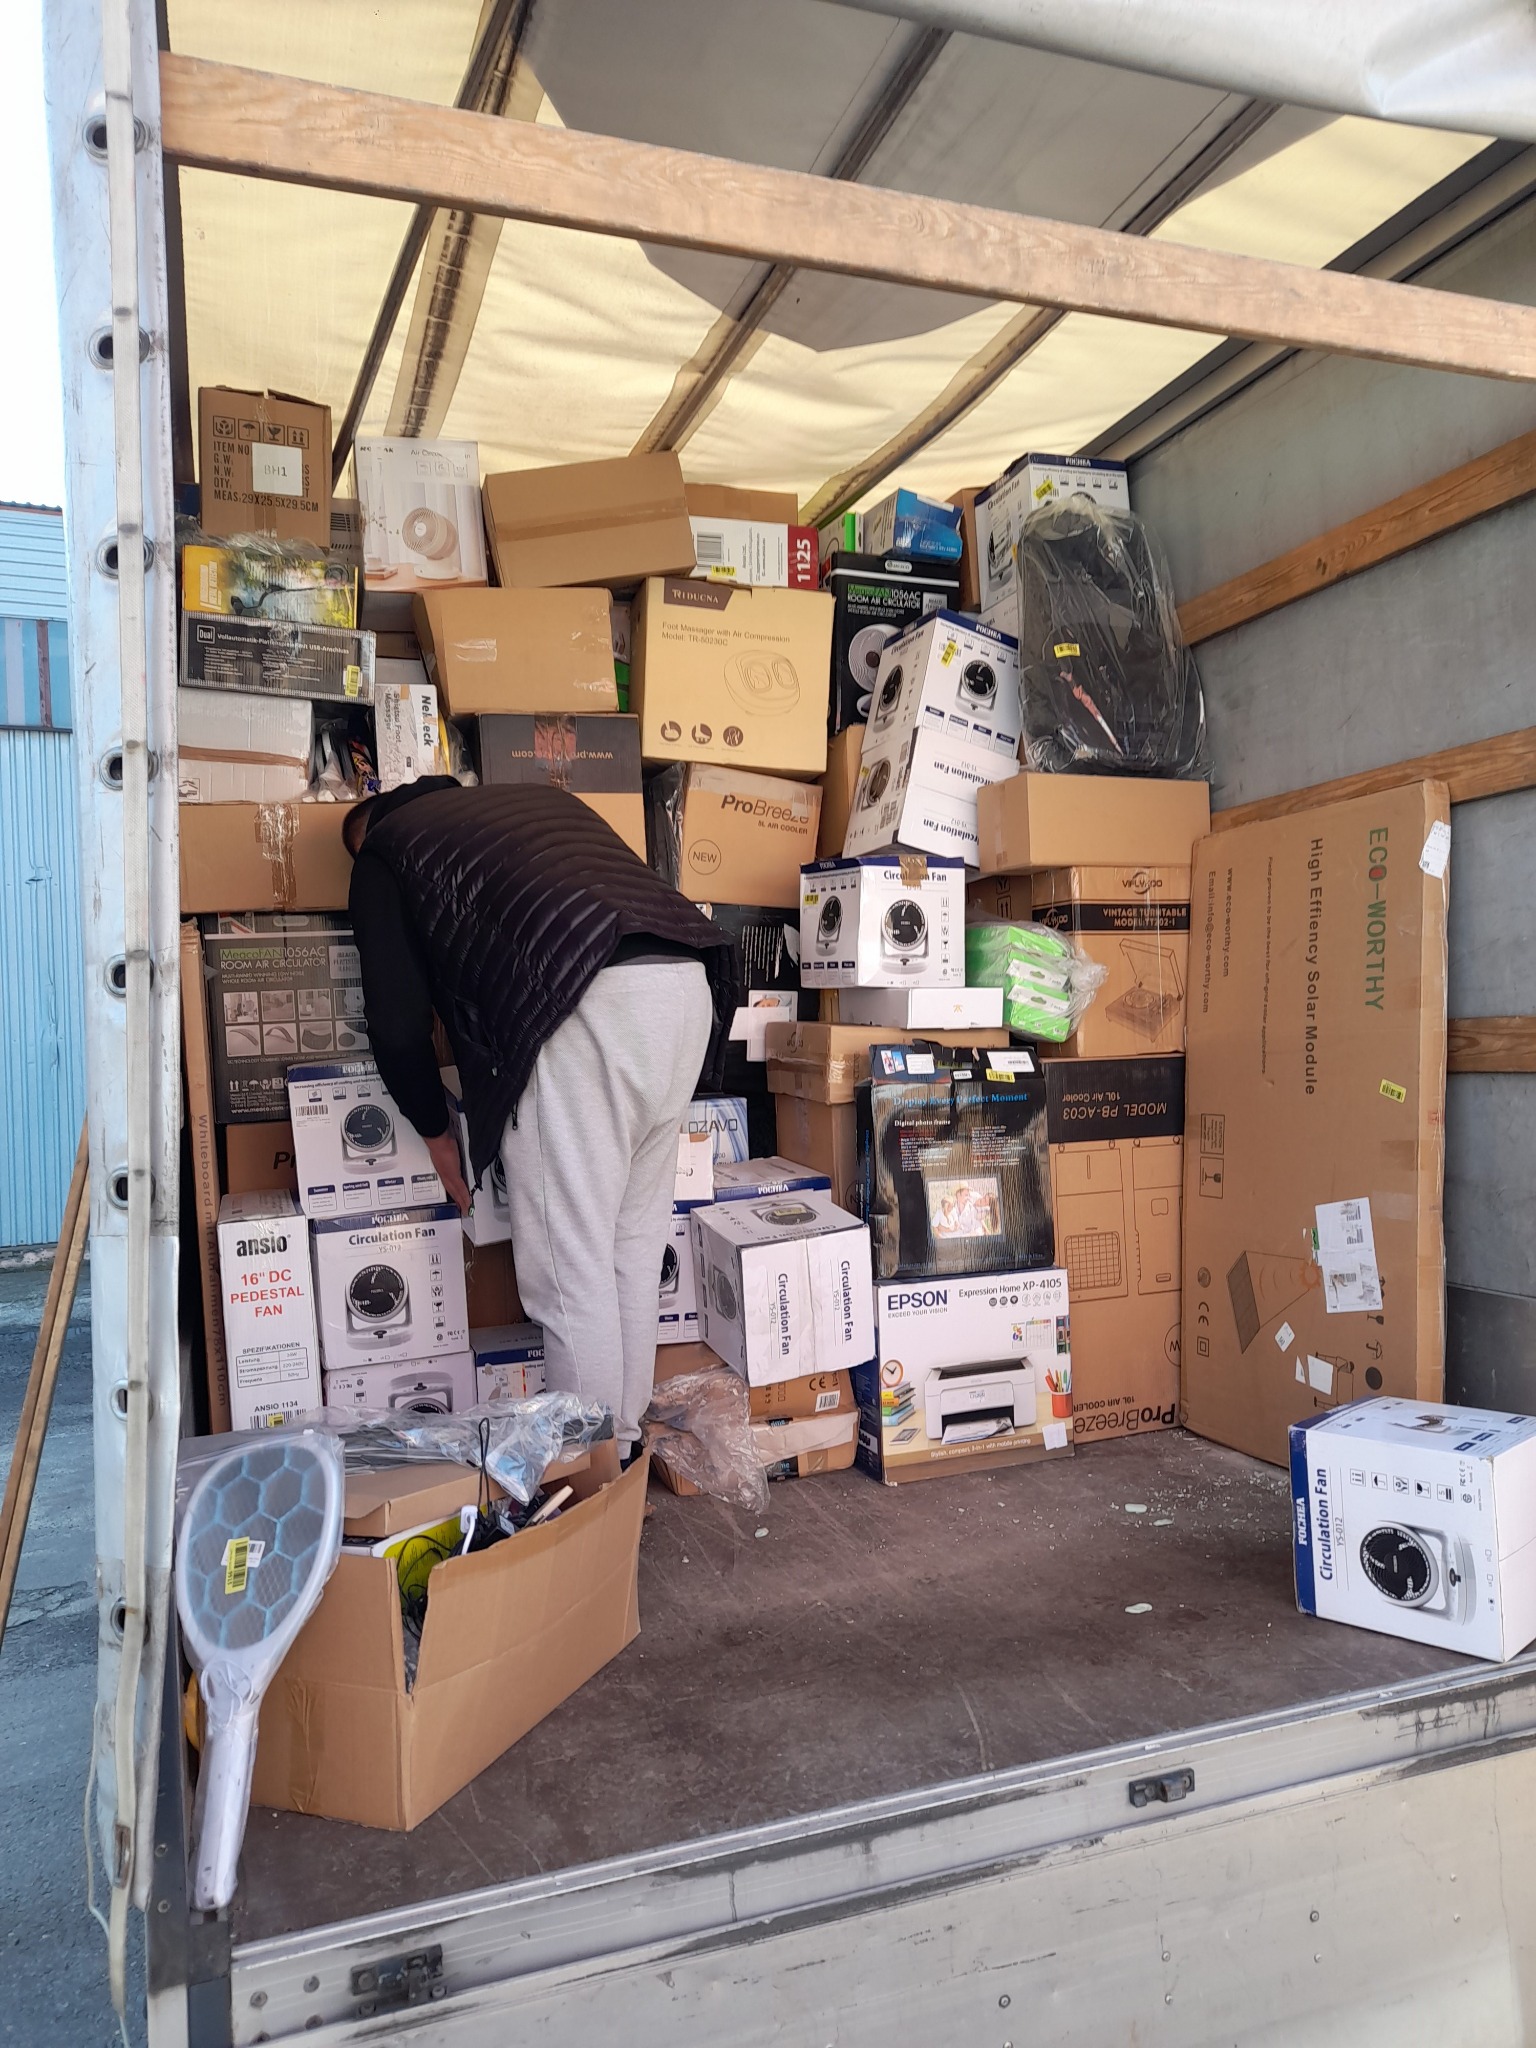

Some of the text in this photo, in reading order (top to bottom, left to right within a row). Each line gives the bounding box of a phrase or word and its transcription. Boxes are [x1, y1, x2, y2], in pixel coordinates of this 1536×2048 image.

[214, 441, 234, 453] ITEM
[264, 464, 287, 477] BH1
[797, 538, 810, 582] 1125
[848, 594, 869, 604] ROOM
[871, 596, 881, 605] AIR
[883, 597, 921, 609] CIRCULATOR
[200, 630, 213, 640] Dual
[662, 622, 790, 643] Foot Massager with Air Compression
[662, 632, 686, 642] Model:
[309, 644, 349, 654] USB-Anschluss
[934, 761, 950, 774] Fan
[780, 824, 808, 835] COOLER
[924, 819, 939, 831] Fan
[693, 851, 717, 863] NEW
[932, 872, 947, 881] Fan
[1102, 908, 1186, 917] VINTAGE TURNTABLE
[1365, 827, 1388, 1010] ECO-WORTHY
[1222, 867, 1234, 977] www.eco-worthy.com
[284, 946, 325, 958] 1056AC
[221, 960, 252, 970] ROOM
[255, 960, 269, 969] AIR
[273, 958, 326, 968] CIRCULATOR
[1305, 838, 1323, 1095] High Effiency Solar Module
[894, 1092, 1027, 1109] Display Every Perfect Moment
[1062, 1092, 1120, 1103] 10L Air Cooler
[231, 1106, 284, 1114] www.meaco.com
[1063, 1102, 1167, 1120] MODEL PB-AC03
[894, 1120, 914, 1129] Digital
[916, 1119, 932, 1128] photo
[198, 1114, 217, 1236] Whiteboard mit
[349, 1227, 436, 1245] Circulation Fan
[236, 1231, 287, 1256] ansio
[269, 1269, 292, 1283] DC
[230, 1286, 304, 1304] PEDESTAL
[959, 1278, 1062, 1300] Expression Home XP-4105
[840, 1260, 853, 1341] Circulation Fan
[888, 1290, 948, 1310] EPSON
[255, 1304, 282, 1318] FAN
[778, 1273, 791, 1355] Circulation Fan
[888, 1310, 911, 1318] EXCEED
[254, 1400, 298, 1412] ANSIO 1134
[1074, 1400, 1105, 1412] COOLER
[1108, 1398, 1119, 1406] AIR
[1074, 1403, 1176, 1434] ProBreeze
[1013, 1438, 1031, 1446] printing
[1297, 1497, 1306, 1545] FOCHEA
[1315, 1468, 1333, 1581] Circulation Fan
[1335, 1517, 1344, 1547] YS-012
